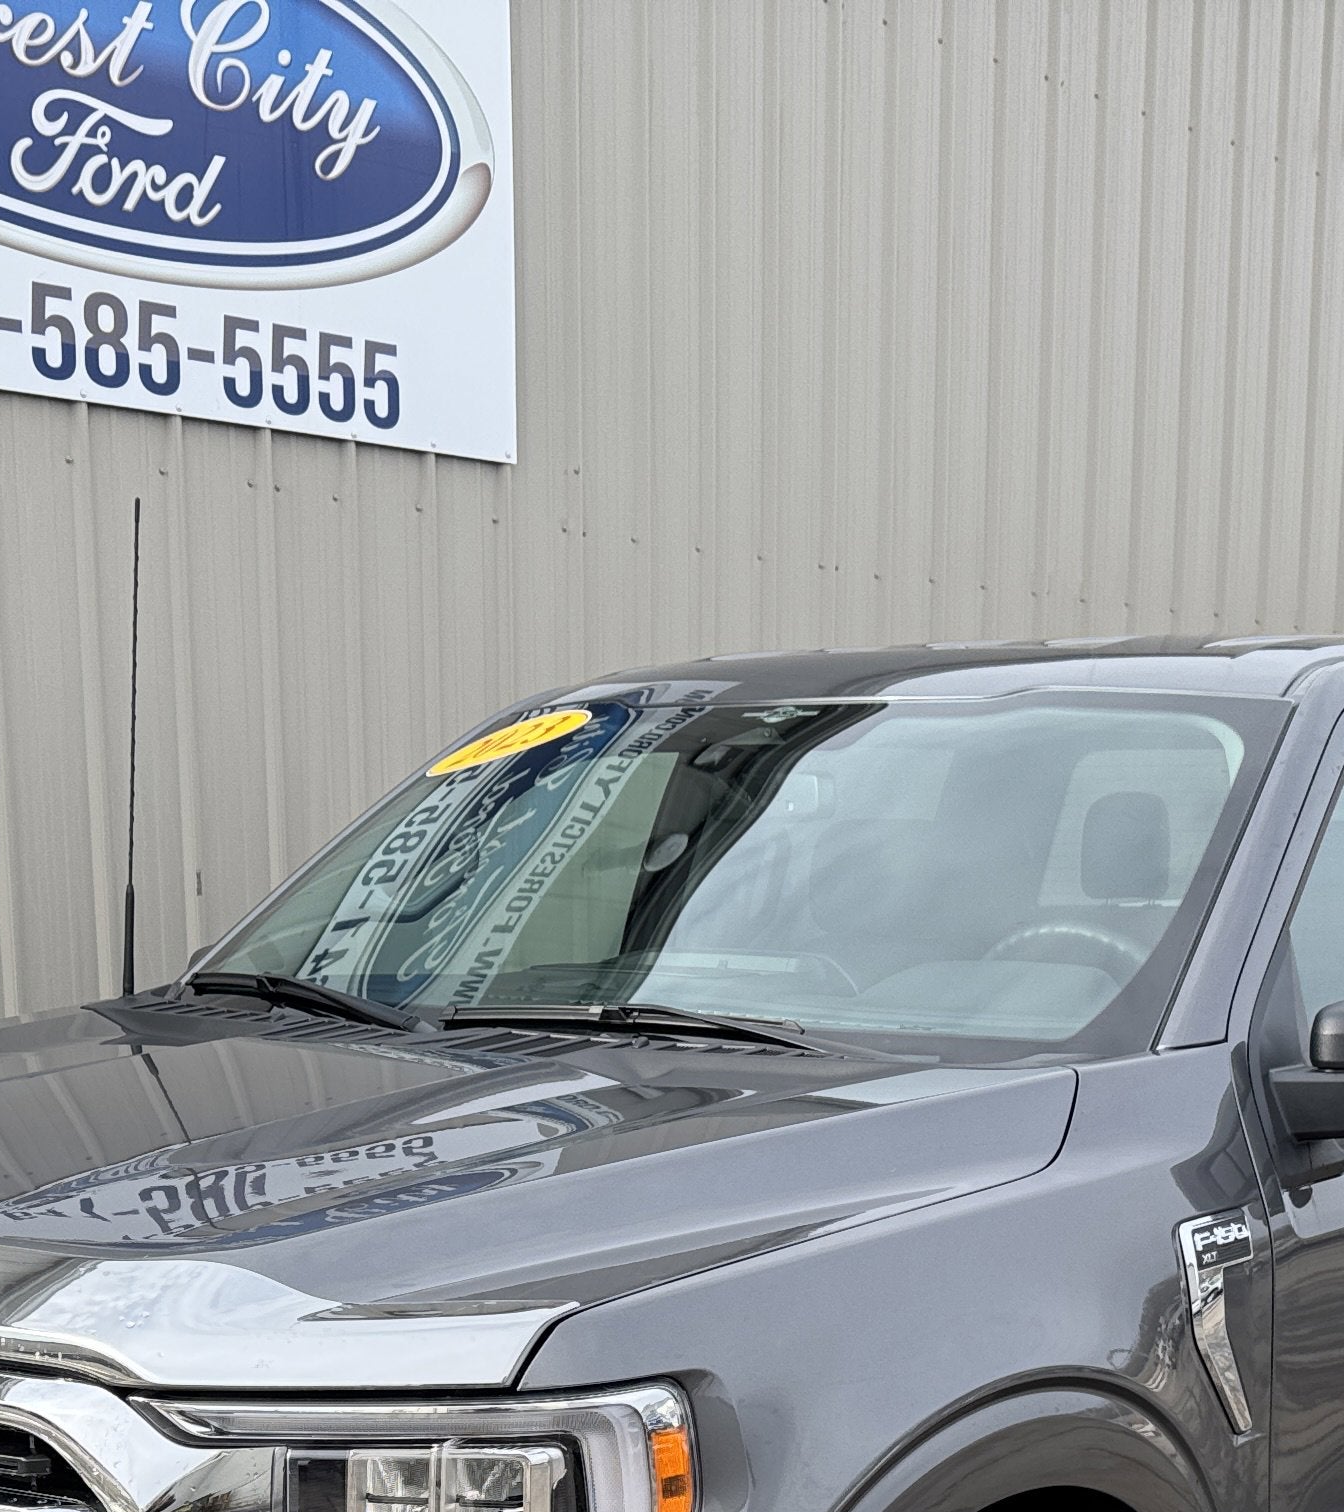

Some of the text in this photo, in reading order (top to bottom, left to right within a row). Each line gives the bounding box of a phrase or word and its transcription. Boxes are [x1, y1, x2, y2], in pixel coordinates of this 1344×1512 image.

[179, 0, 382, 181] City
[10, 88, 227, 227] Ford
[1193, 1222, 1251, 1251] F-150
[1201, 1251, 1218, 1265] XLT
